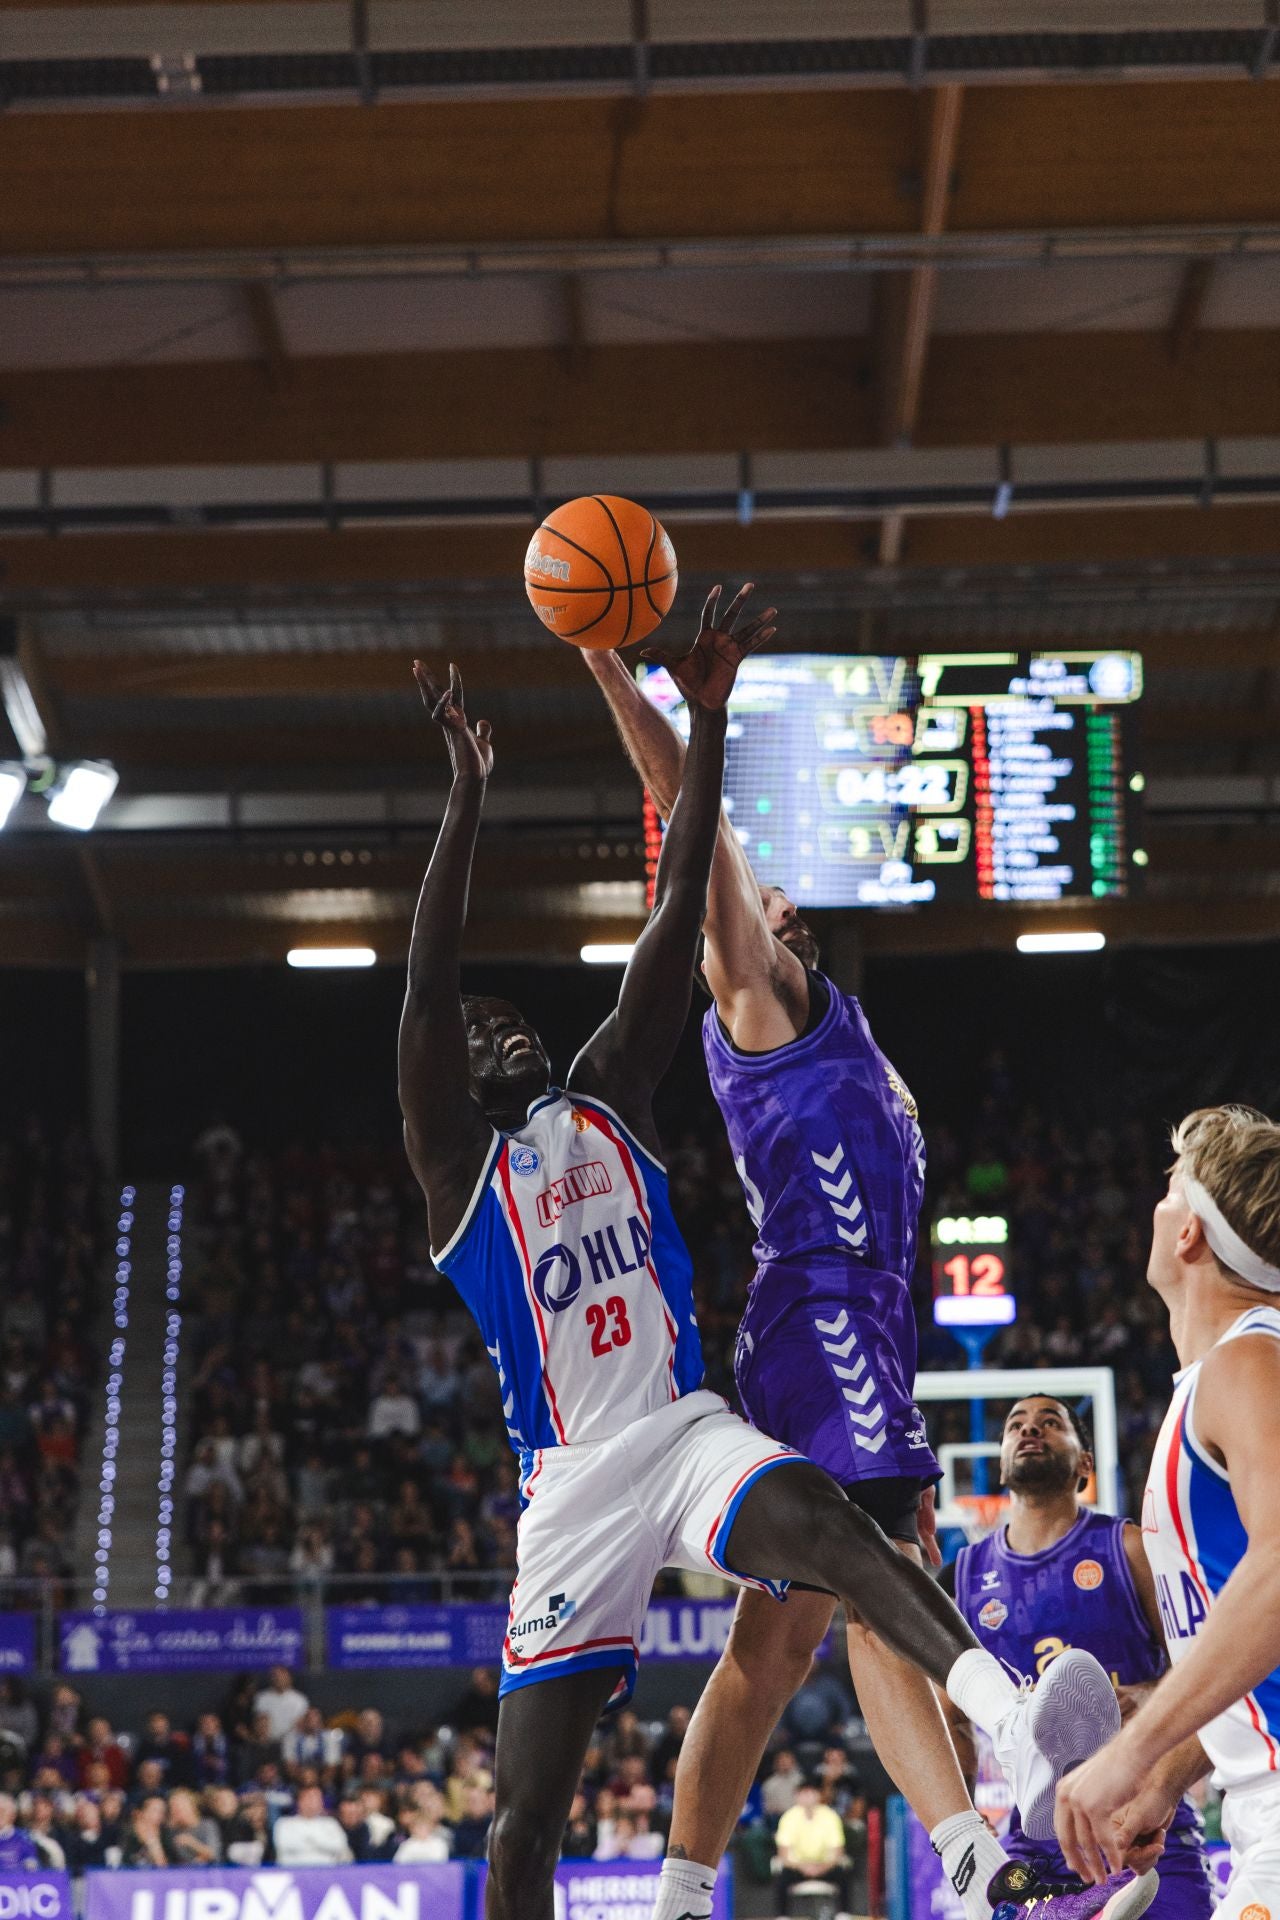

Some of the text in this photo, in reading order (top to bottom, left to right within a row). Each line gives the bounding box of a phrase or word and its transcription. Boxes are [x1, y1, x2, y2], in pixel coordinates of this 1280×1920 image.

[836, 766, 950, 806] 04:22
[943, 1253, 1006, 1296] 12
[585, 1295, 632, 1358] 23
[509, 1614, 558, 1640] suma
